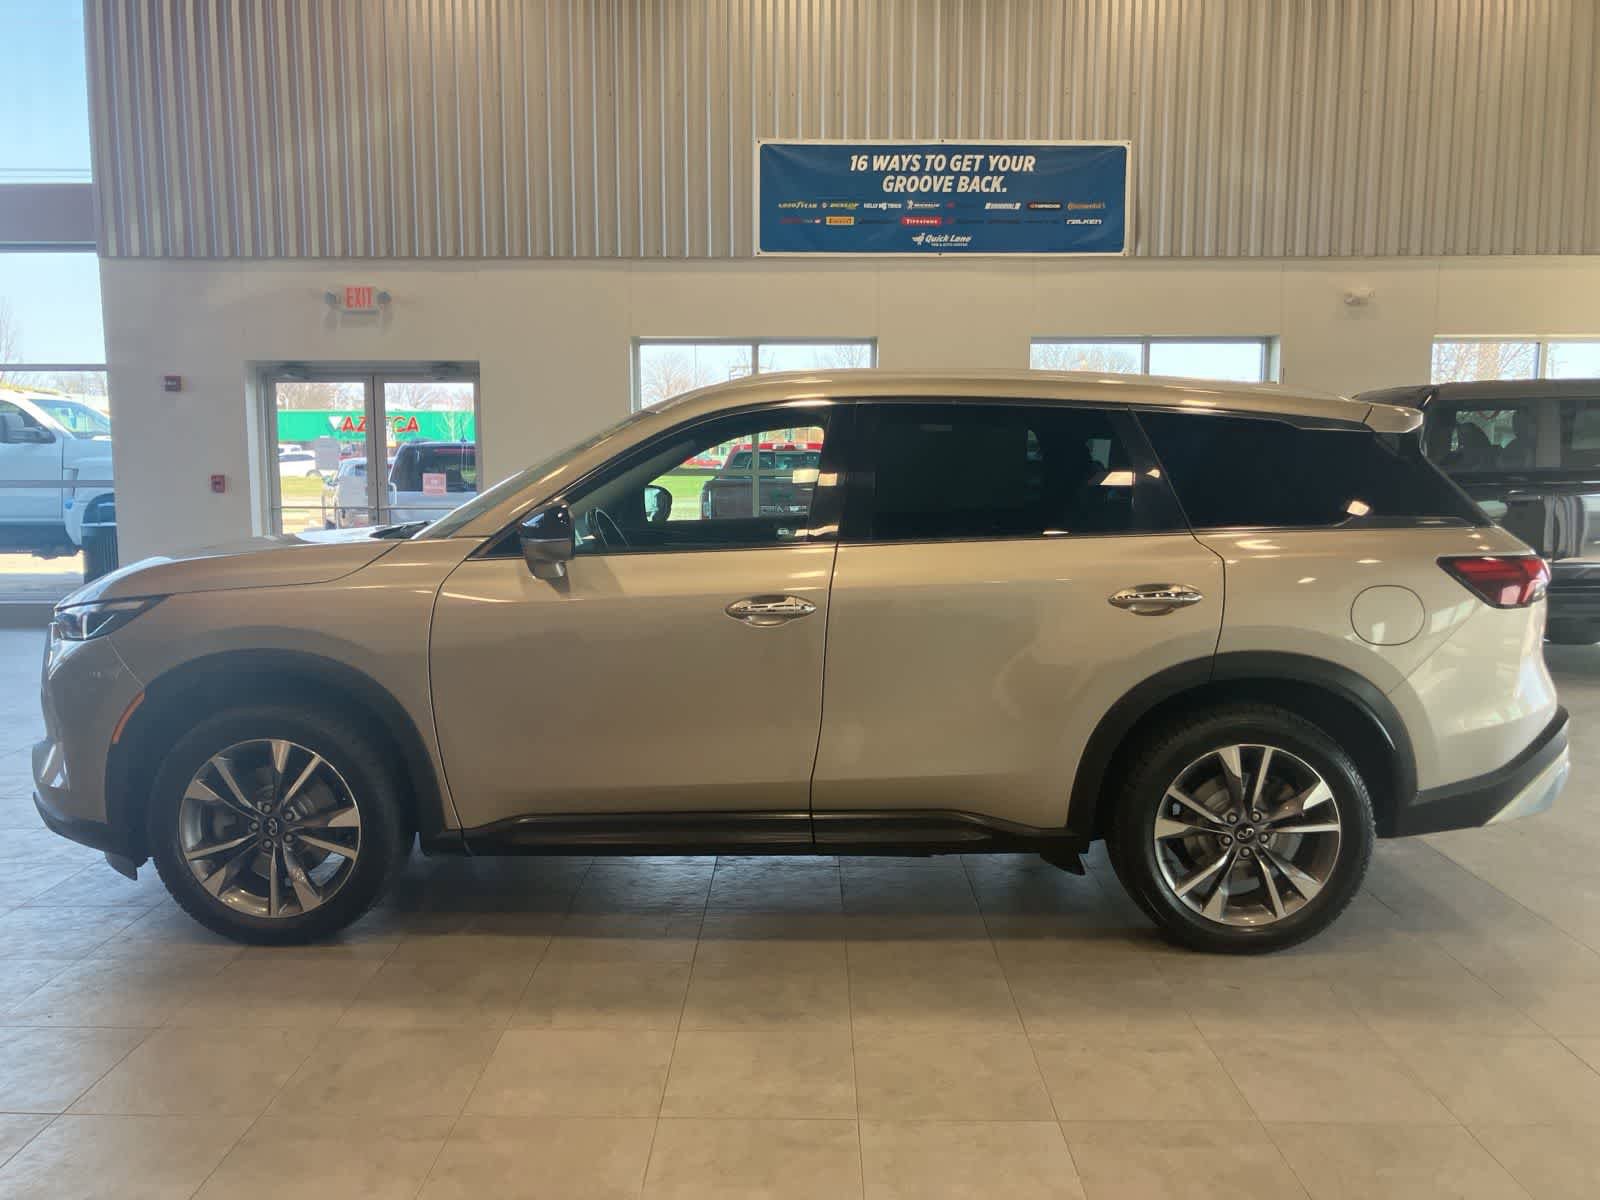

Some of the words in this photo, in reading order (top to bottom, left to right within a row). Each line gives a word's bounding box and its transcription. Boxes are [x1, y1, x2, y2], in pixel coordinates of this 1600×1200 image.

[850, 154, 869, 171] 16
[872, 154, 921, 171] WAYS
[925, 154, 947, 171] TO
[949, 154, 984, 172] GET
[988, 154, 1036, 172] YOUR
[882, 175, 954, 193] GROOVE
[956, 175, 1007, 193] BACK.
[925, 234, 949, 243] Quick
[950, 234, 972, 243] Lane
[345, 287, 373, 308] EXIT
[341, 415, 419, 433] AZCA
